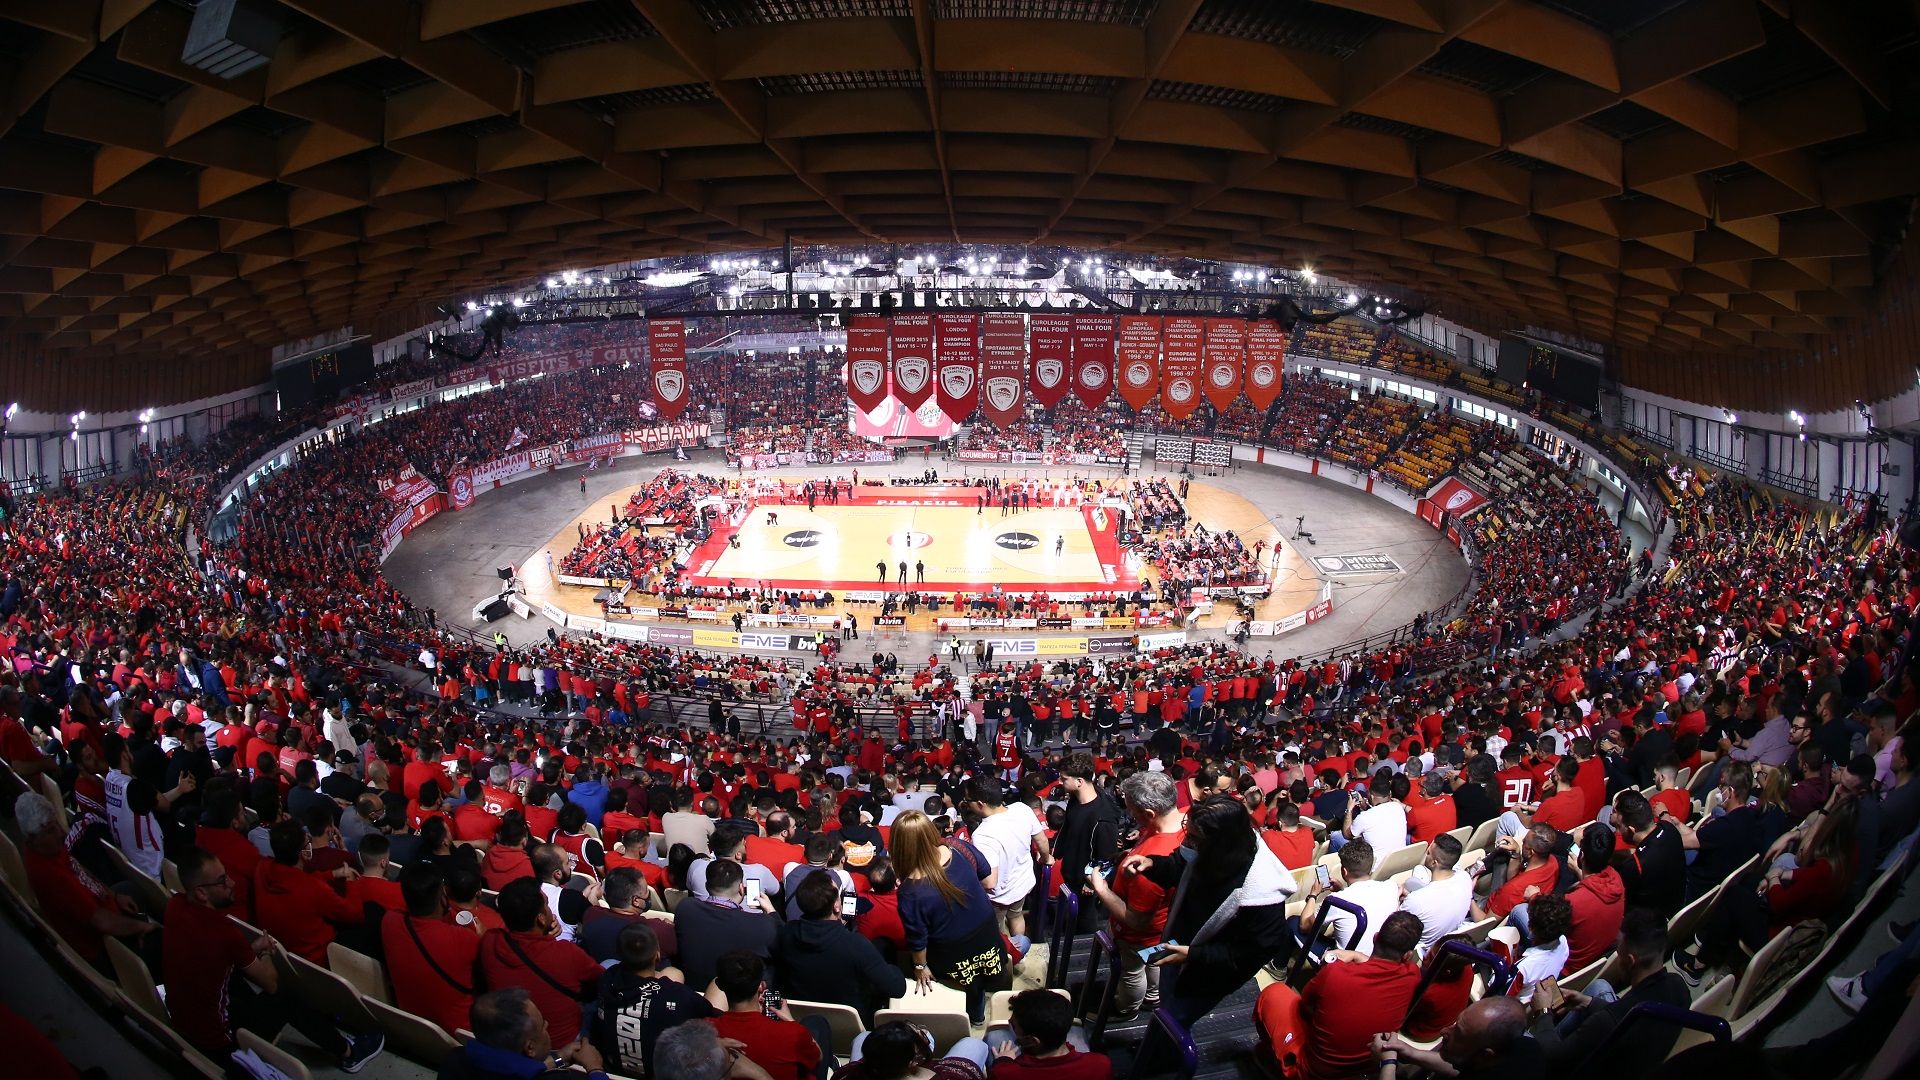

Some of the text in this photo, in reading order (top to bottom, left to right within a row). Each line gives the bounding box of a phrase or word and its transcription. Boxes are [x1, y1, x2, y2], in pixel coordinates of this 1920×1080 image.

[497, 356, 570, 380] MISFITS
[996, 536, 1040, 547] bwin
[1346, 555, 1388, 564] official
[1352, 563, 1386, 571] store
[778, 616, 807, 624] FMS
[741, 634, 788, 651] FMS
[1152, 637, 1183, 646] COSMOTE
[1002, 747, 1010, 757] 7
[1504, 779, 1532, 808] 20
[956, 959, 970, 971] IN
